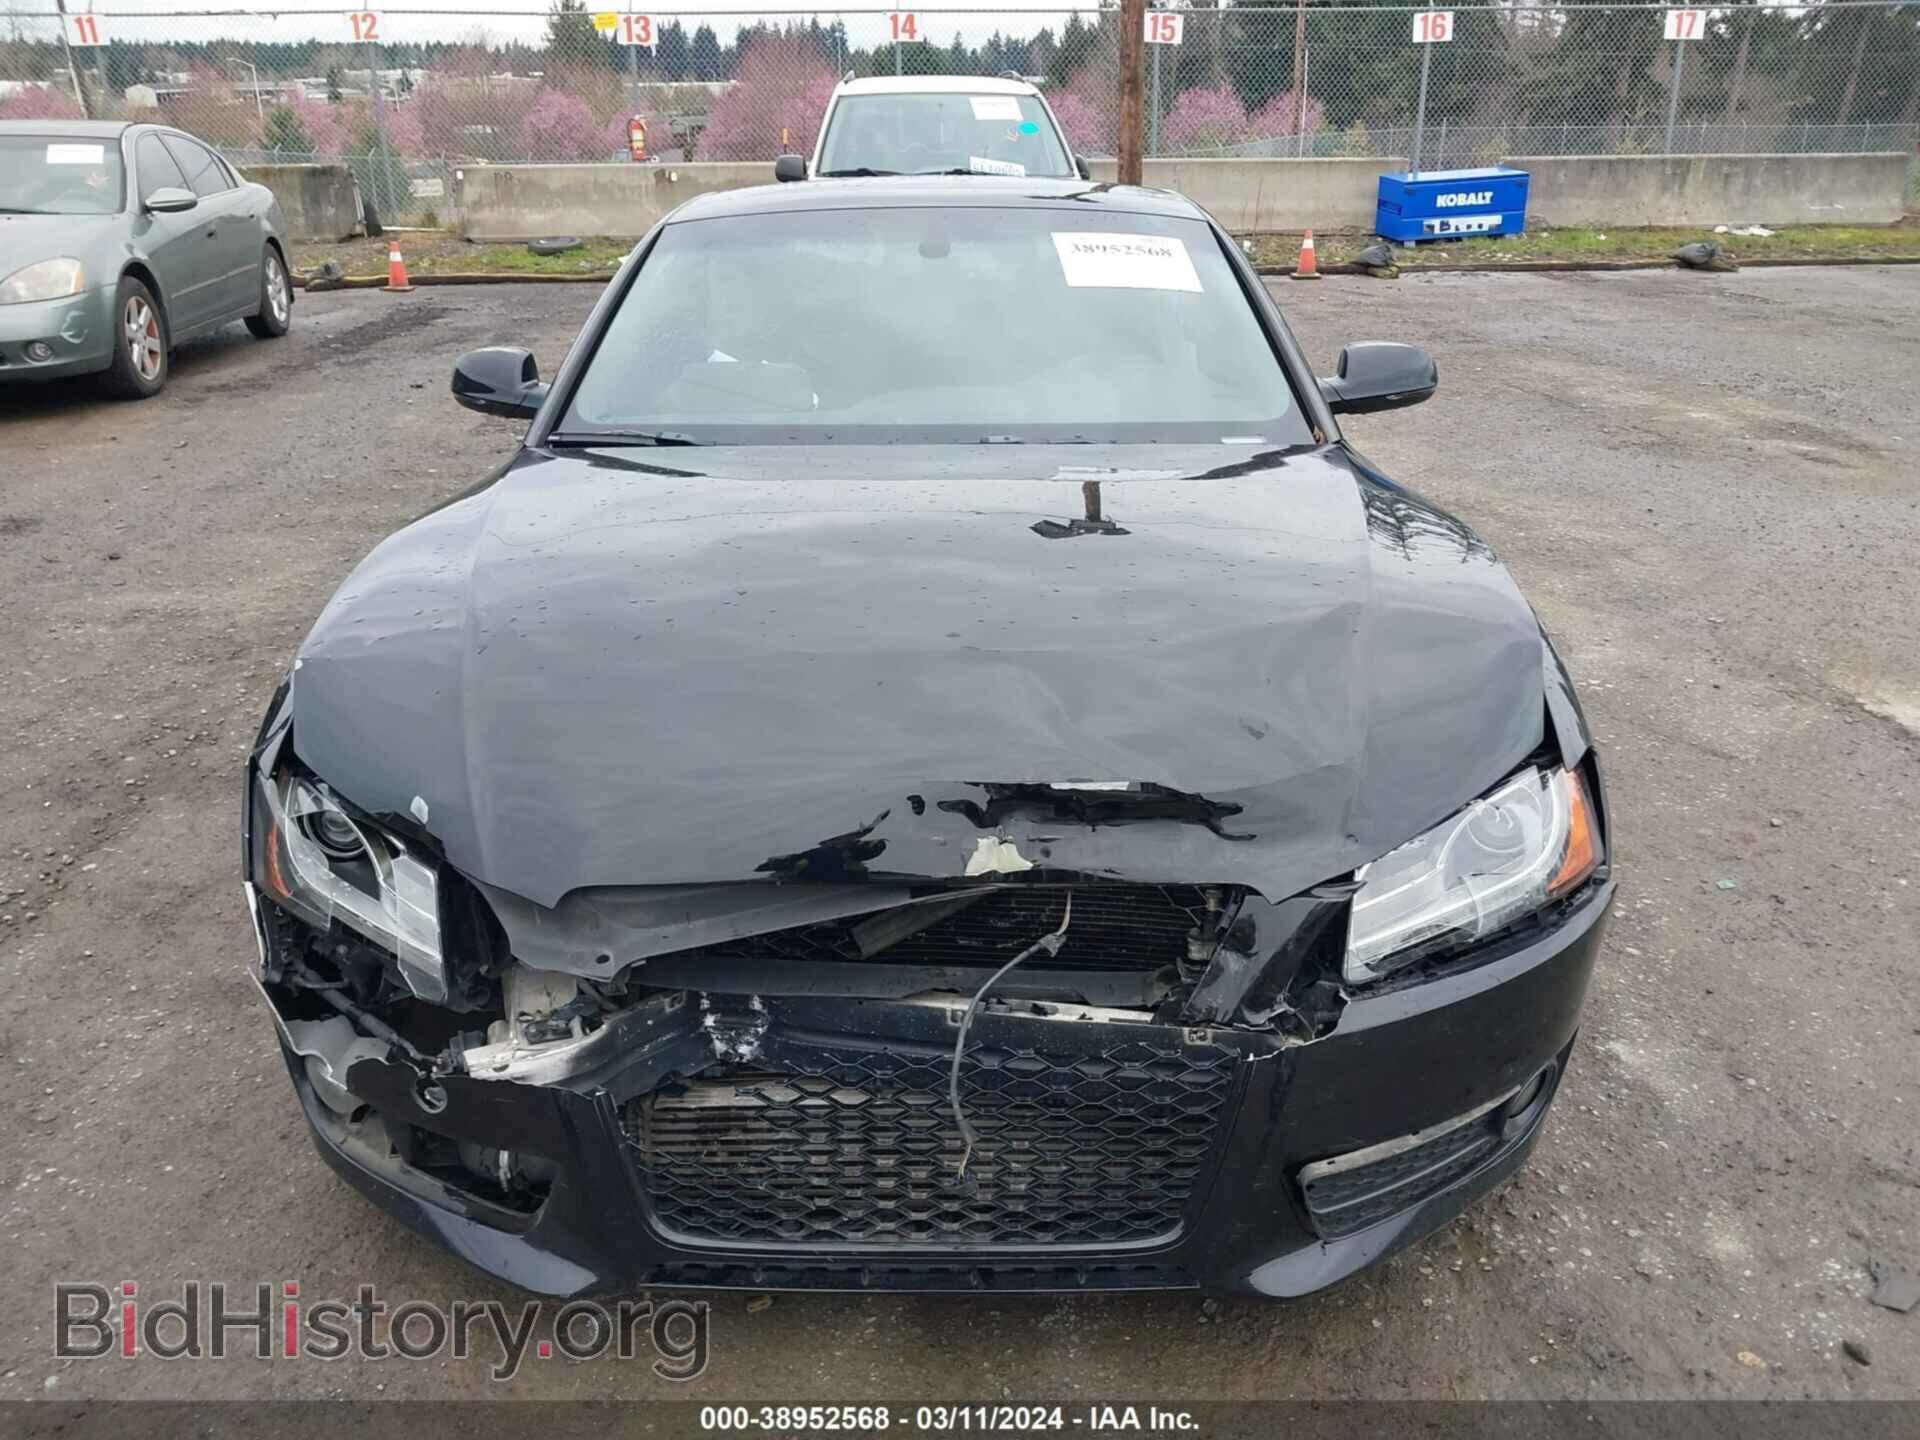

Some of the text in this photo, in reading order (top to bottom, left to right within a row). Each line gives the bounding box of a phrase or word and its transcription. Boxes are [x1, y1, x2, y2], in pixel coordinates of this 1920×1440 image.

[74, 16, 99, 43] 11
[350, 13, 379, 40] 12
[623, 15, 651, 42] 13
[890, 14, 917, 39] 14
[1150, 14, 1176, 41] 15
[1420, 14, 1446, 41] 16
[1675, 11, 1697, 38] 17
[1436, 191, 1493, 208] KOBALT
